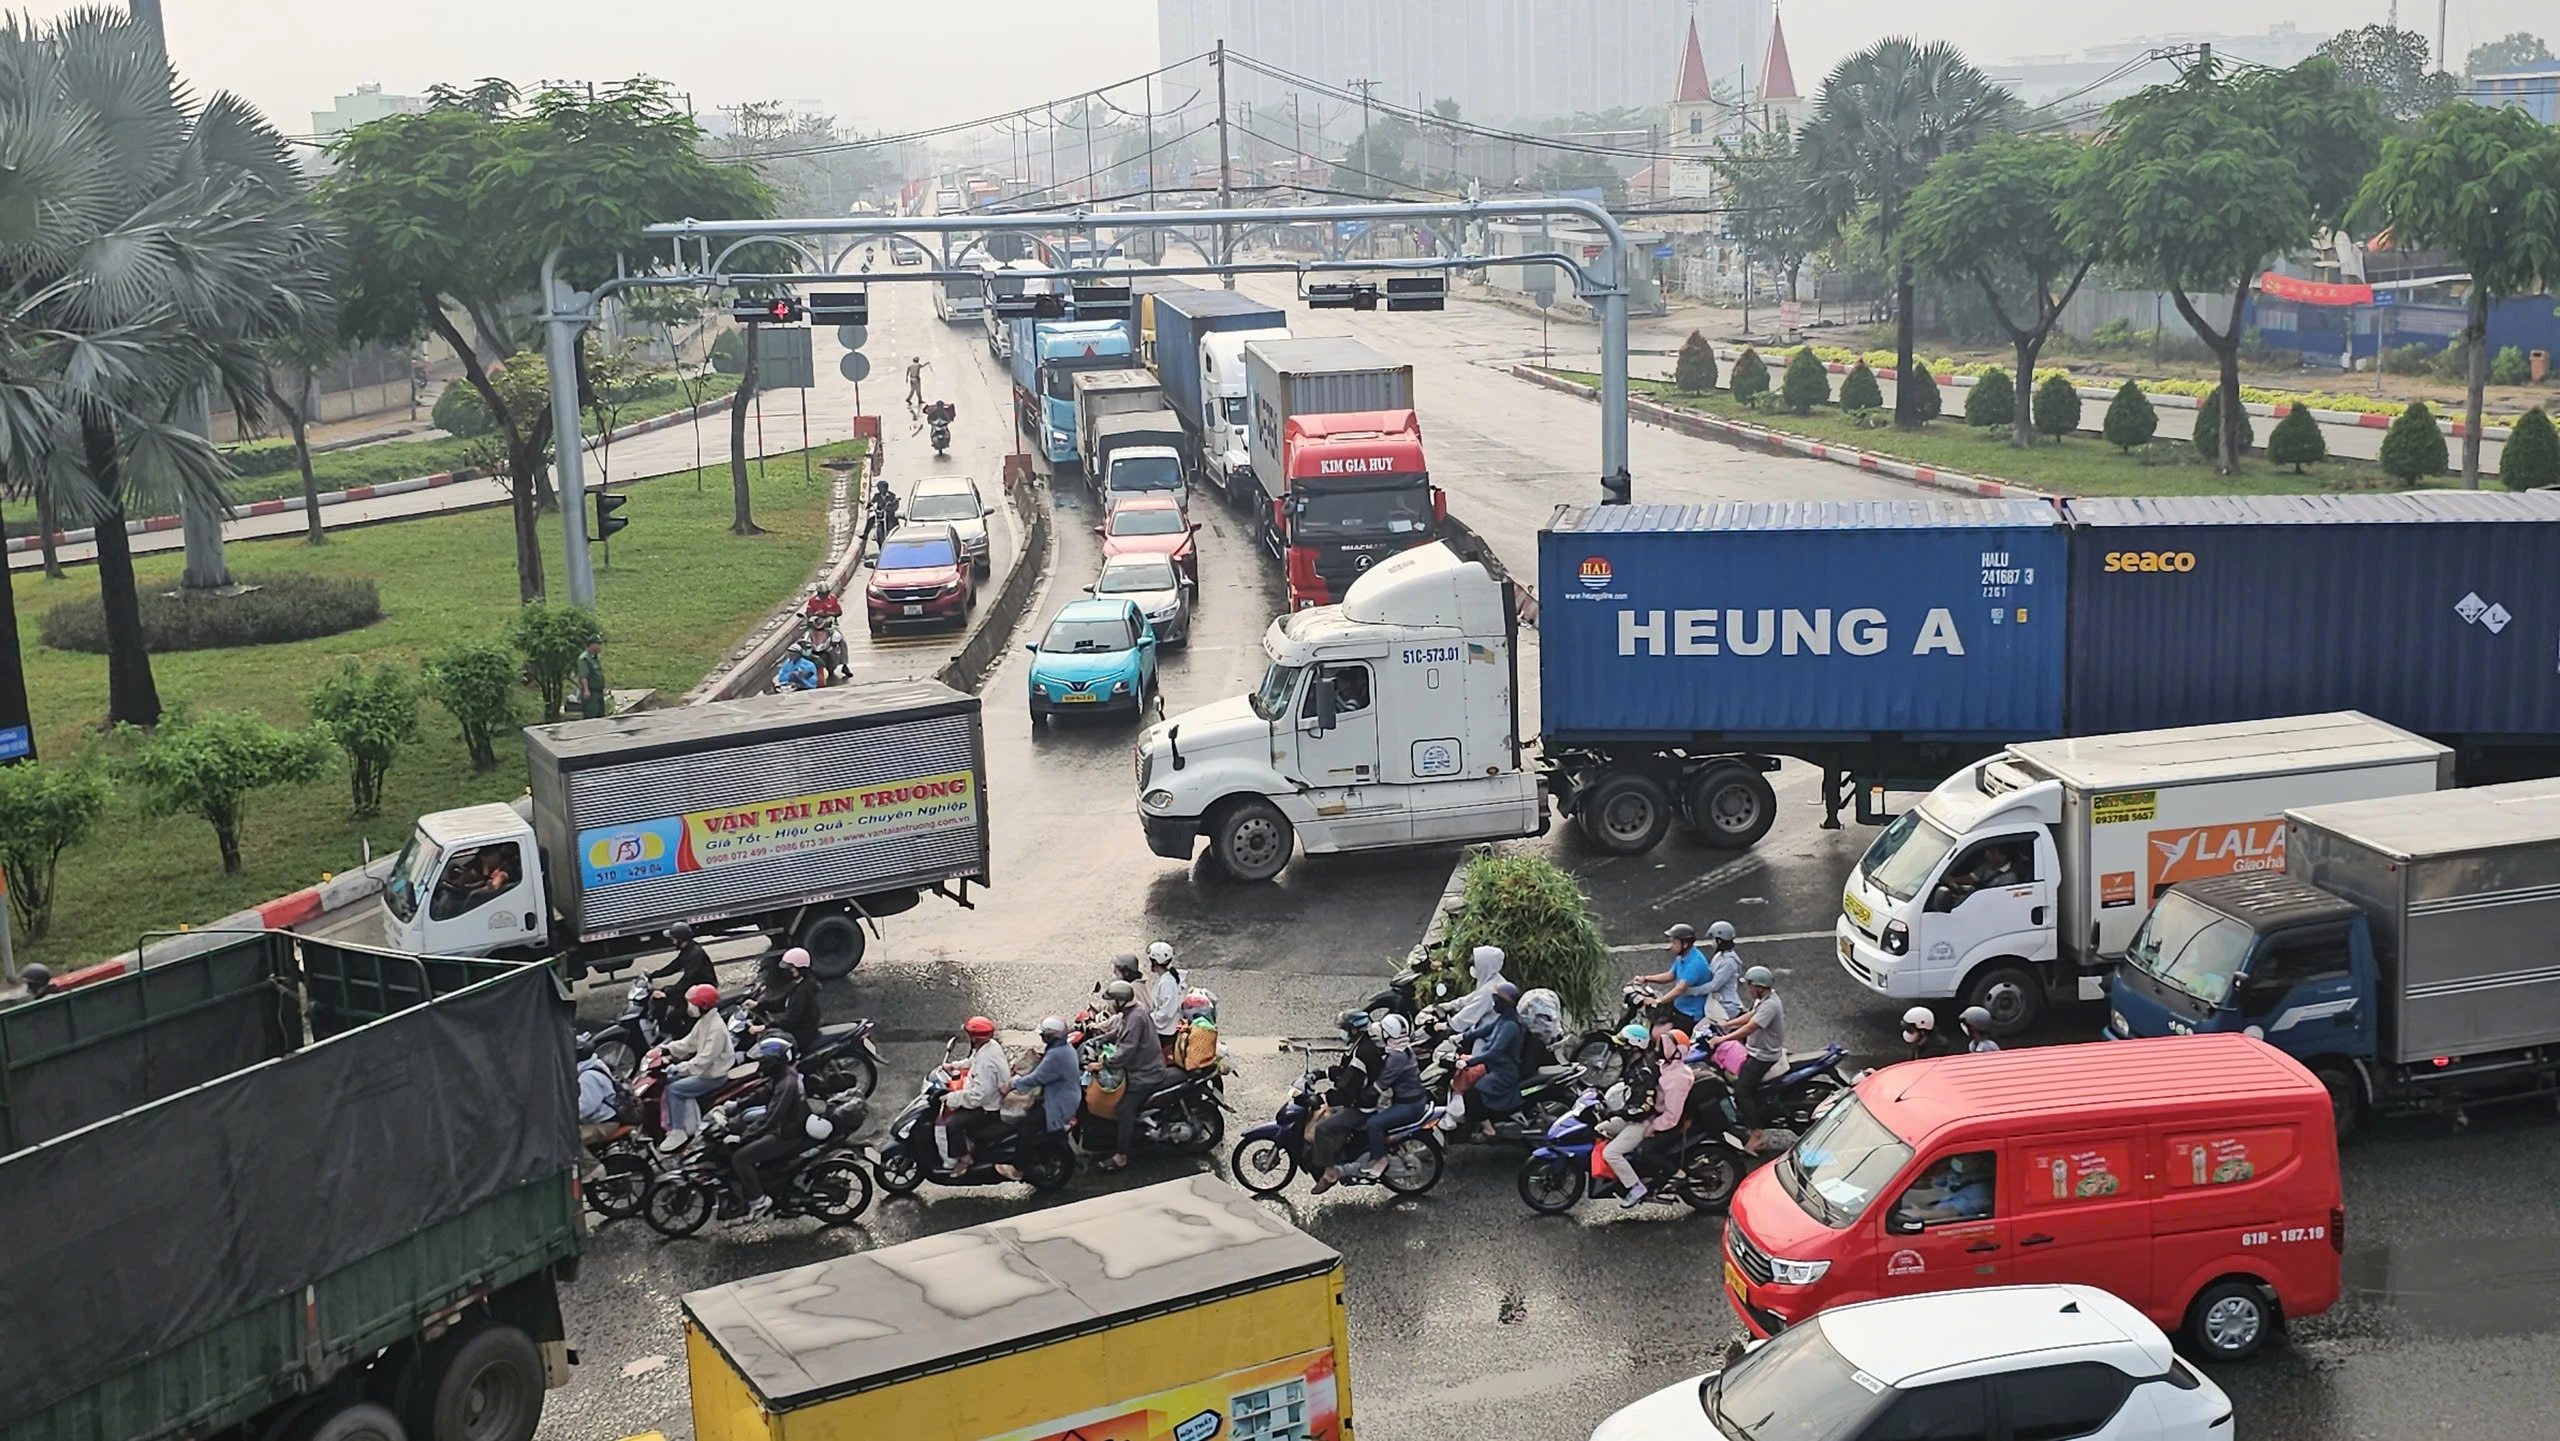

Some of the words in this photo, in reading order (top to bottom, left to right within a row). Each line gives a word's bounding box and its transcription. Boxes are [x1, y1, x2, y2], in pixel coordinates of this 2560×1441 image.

[1321, 460, 1344, 474] KIM
[1345, 458, 1367, 473] GIA
[1369, 457, 1394, 472] HUY
[1582, 563, 1611, 574] HAL
[1981, 552, 2009, 567] HALU
[2104, 551, 2195, 572] seaco
[1981, 569, 2020, 584] 241687
[2024, 568, 2034, 584] 3
[1618, 608, 1888, 656] HEUNG
[1912, 608, 1965, 655] A
[1403, 647, 1459, 664] 51C-573.01
[818, 796, 854, 816] AN
[2196, 825, 2286, 860] LALA
[706, 854, 729, 865] 0908
[731, 850, 748, 860] 072
[751, 847, 767, 856] 499
[800, 839, 816, 849] 673
